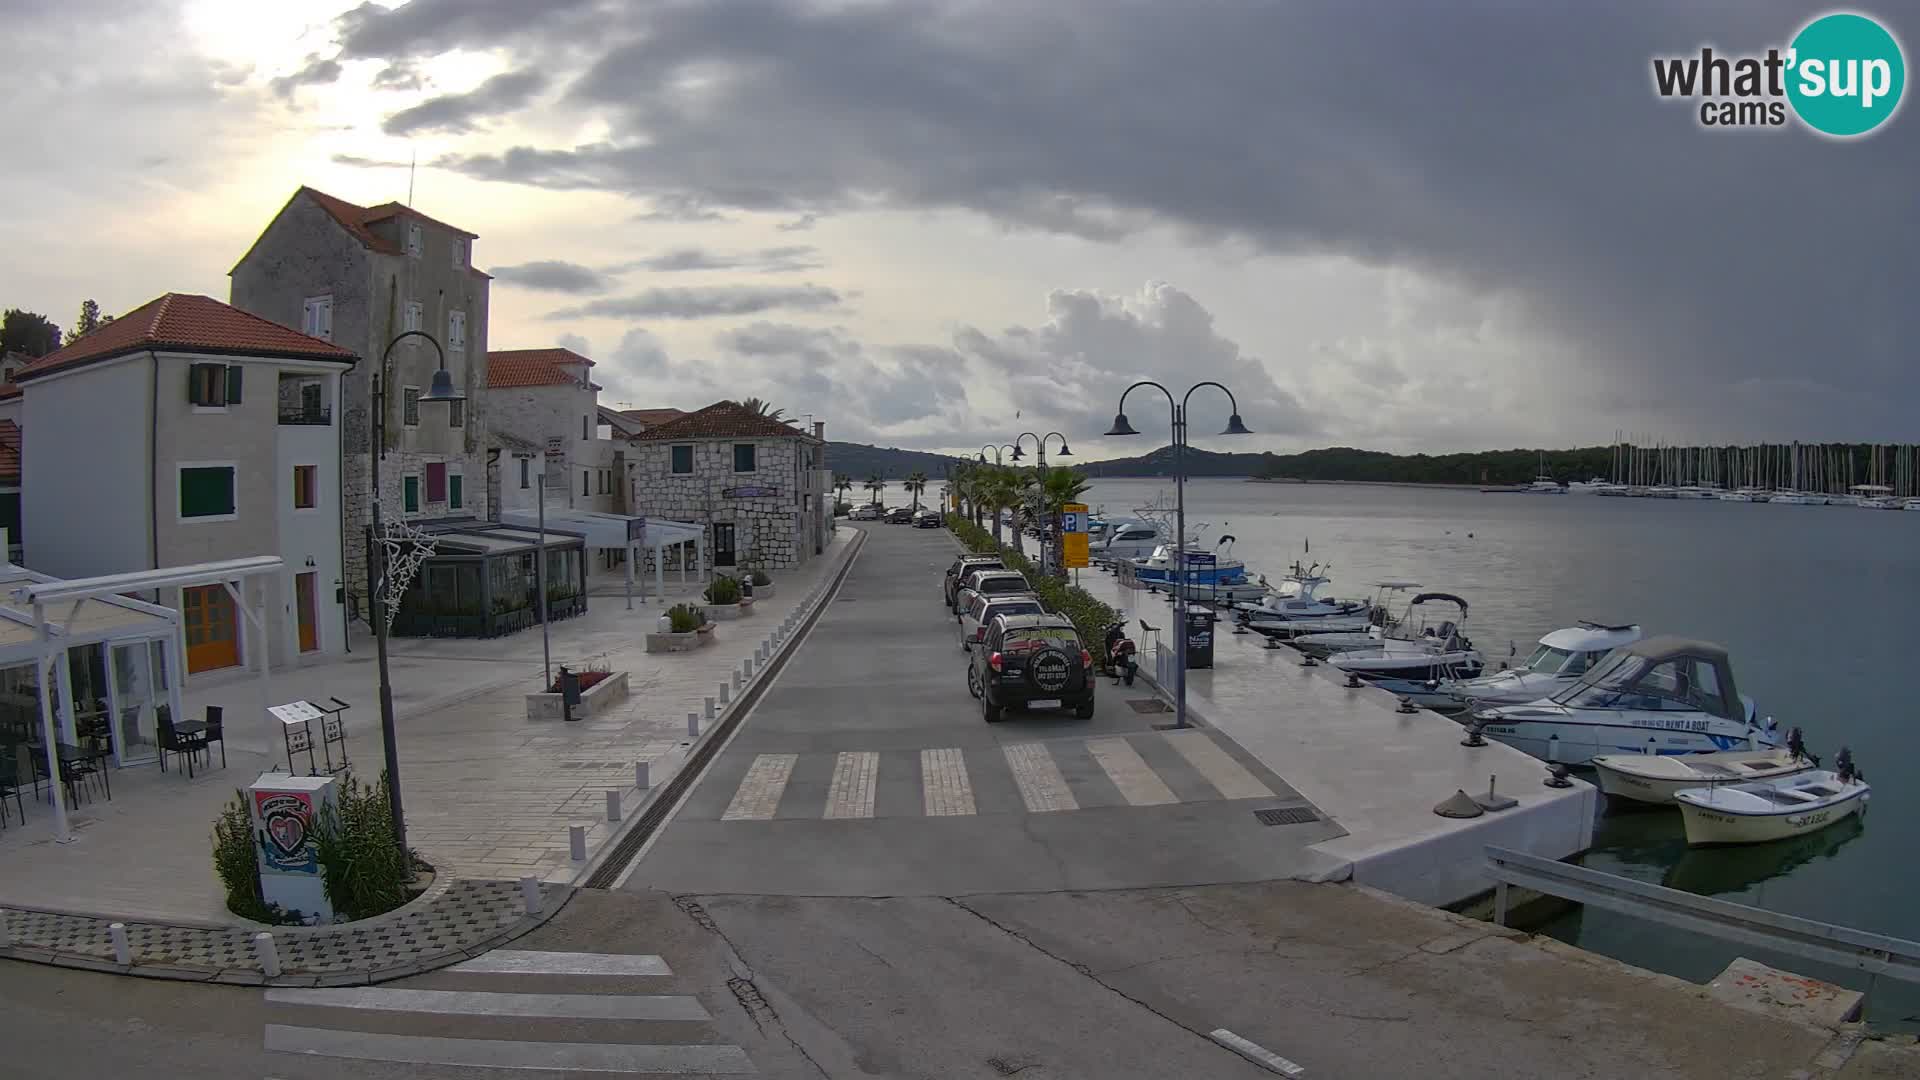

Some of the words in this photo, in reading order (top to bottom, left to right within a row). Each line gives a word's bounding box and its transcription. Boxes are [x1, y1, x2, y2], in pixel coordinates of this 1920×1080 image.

[1064, 514, 1076, 531] P
[1665, 719, 1684, 729] RENT
[1684, 720, 1690, 730] A
[1691, 720, 1711, 732] BOAT
